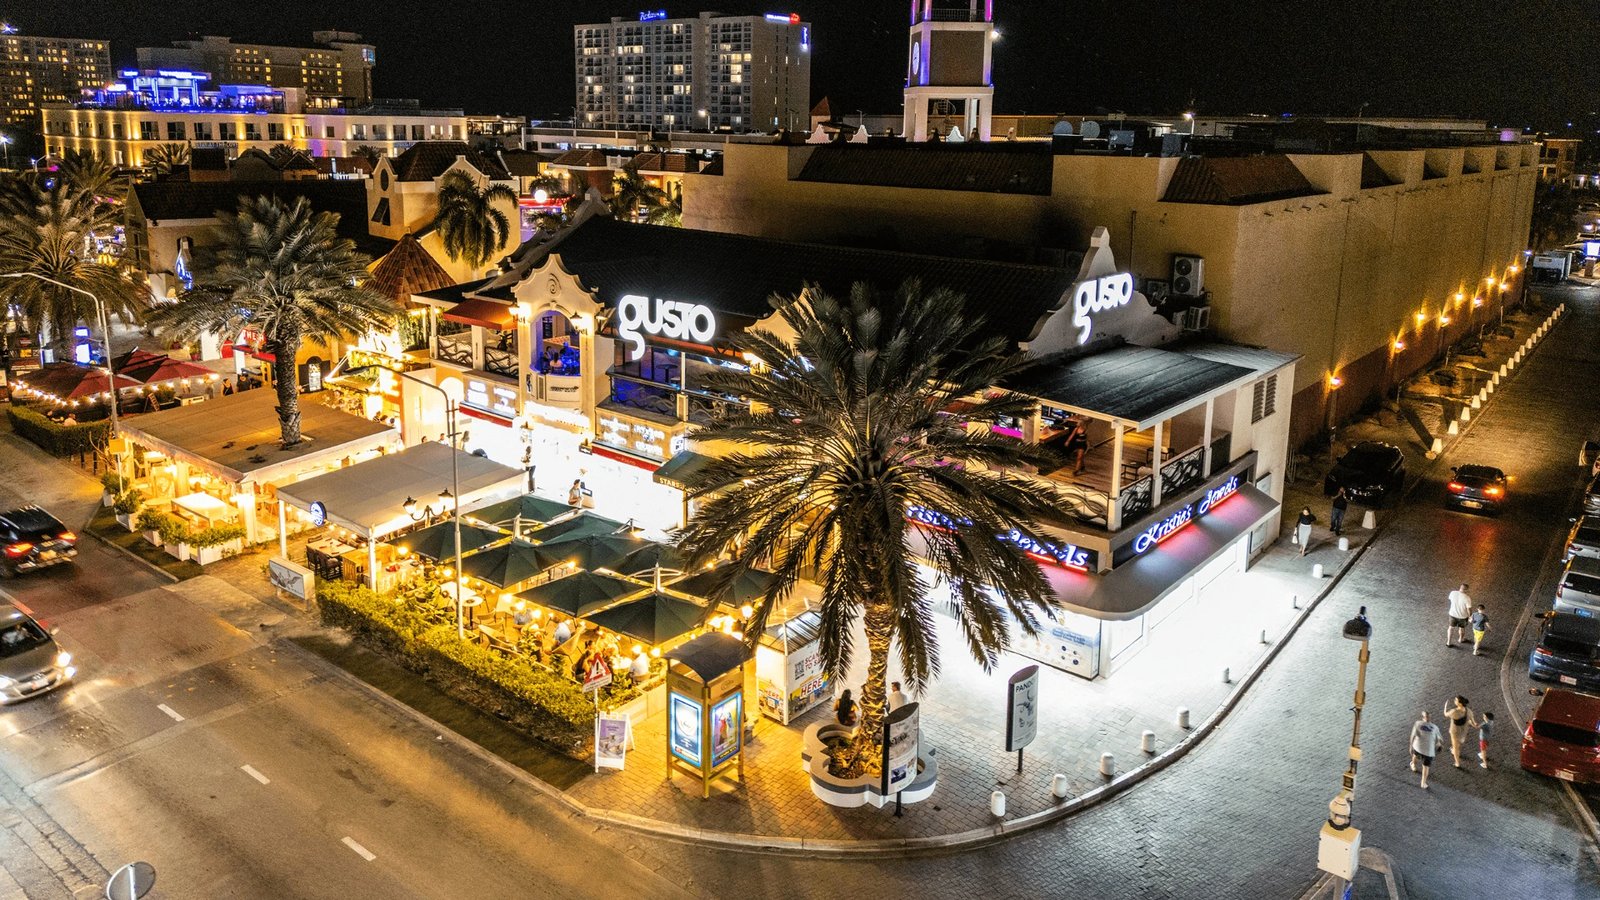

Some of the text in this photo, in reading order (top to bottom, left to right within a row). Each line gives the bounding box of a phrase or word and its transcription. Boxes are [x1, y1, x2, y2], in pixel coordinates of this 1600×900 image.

[1135, 476, 1238, 553] Kristie's Jewels
[801, 677, 822, 697] HERE
